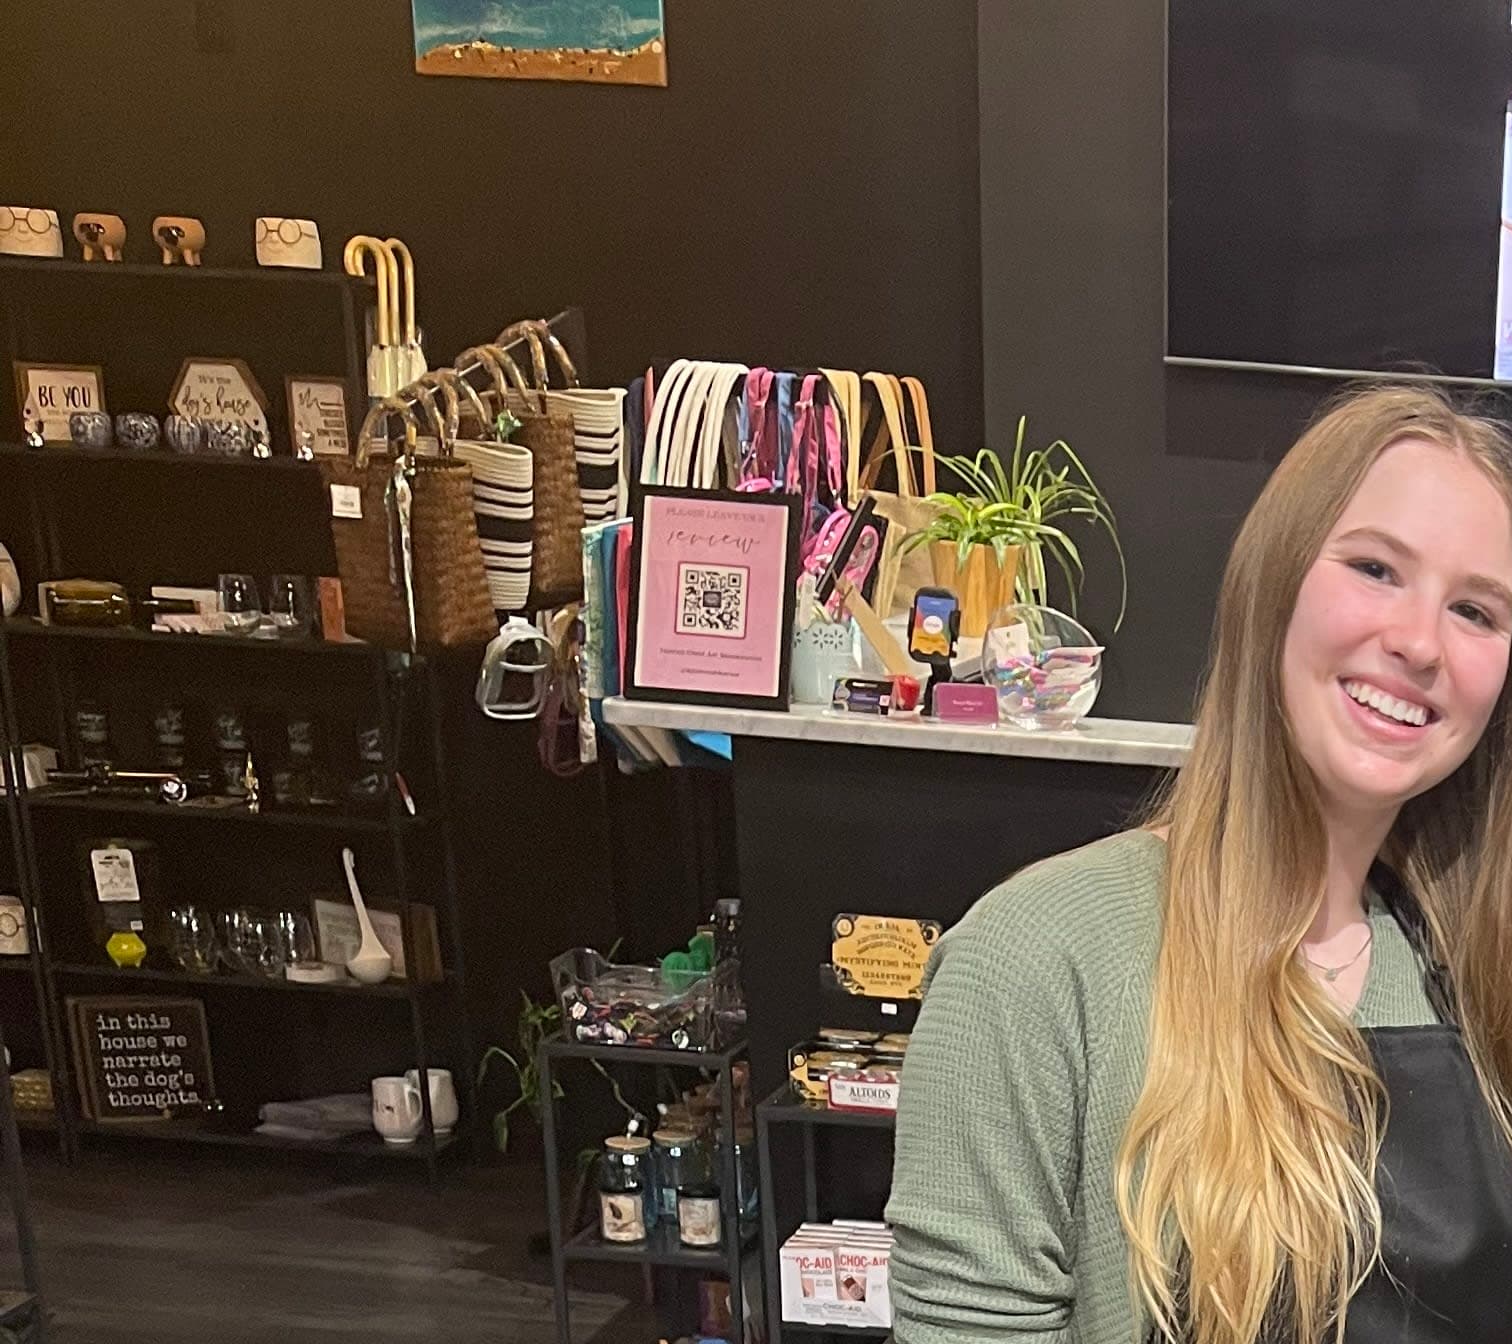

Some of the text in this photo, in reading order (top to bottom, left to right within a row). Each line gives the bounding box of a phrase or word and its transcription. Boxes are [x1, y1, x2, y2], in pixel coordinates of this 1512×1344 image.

[38, 385, 91, 409] BE YOU
[667, 530, 761, 554] review
[97, 1013, 171, 1031] in this
[99, 1033, 188, 1050] house we
[103, 1050, 181, 1069] narrate
[105, 1069, 195, 1090] the dog's
[108, 1090, 200, 1109] thoughts
[849, 1086, 891, 1099] ALTOIDS
[796, 1256, 832, 1269] OC-AID
